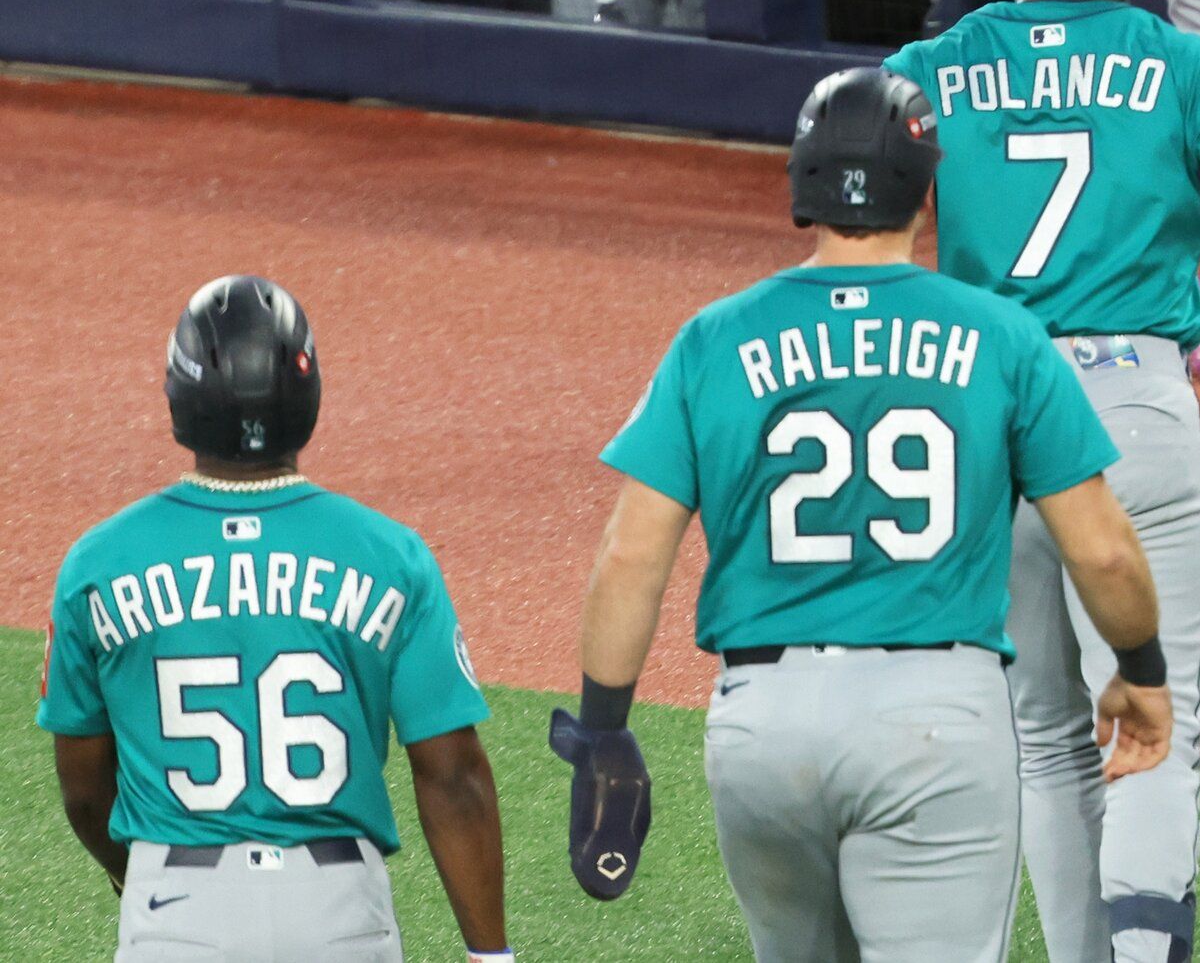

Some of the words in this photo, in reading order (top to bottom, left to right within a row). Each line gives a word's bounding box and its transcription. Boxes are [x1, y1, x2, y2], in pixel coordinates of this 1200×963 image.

[936, 54, 1166, 118] POLANCO
[844, 169, 866, 189] 29
[1006, 130, 1093, 279] 7
[737, 318, 980, 399] RALEIGH
[766, 408, 957, 564] 29
[86, 551, 407, 654] AROZARENA
[153, 651, 350, 813] 56
